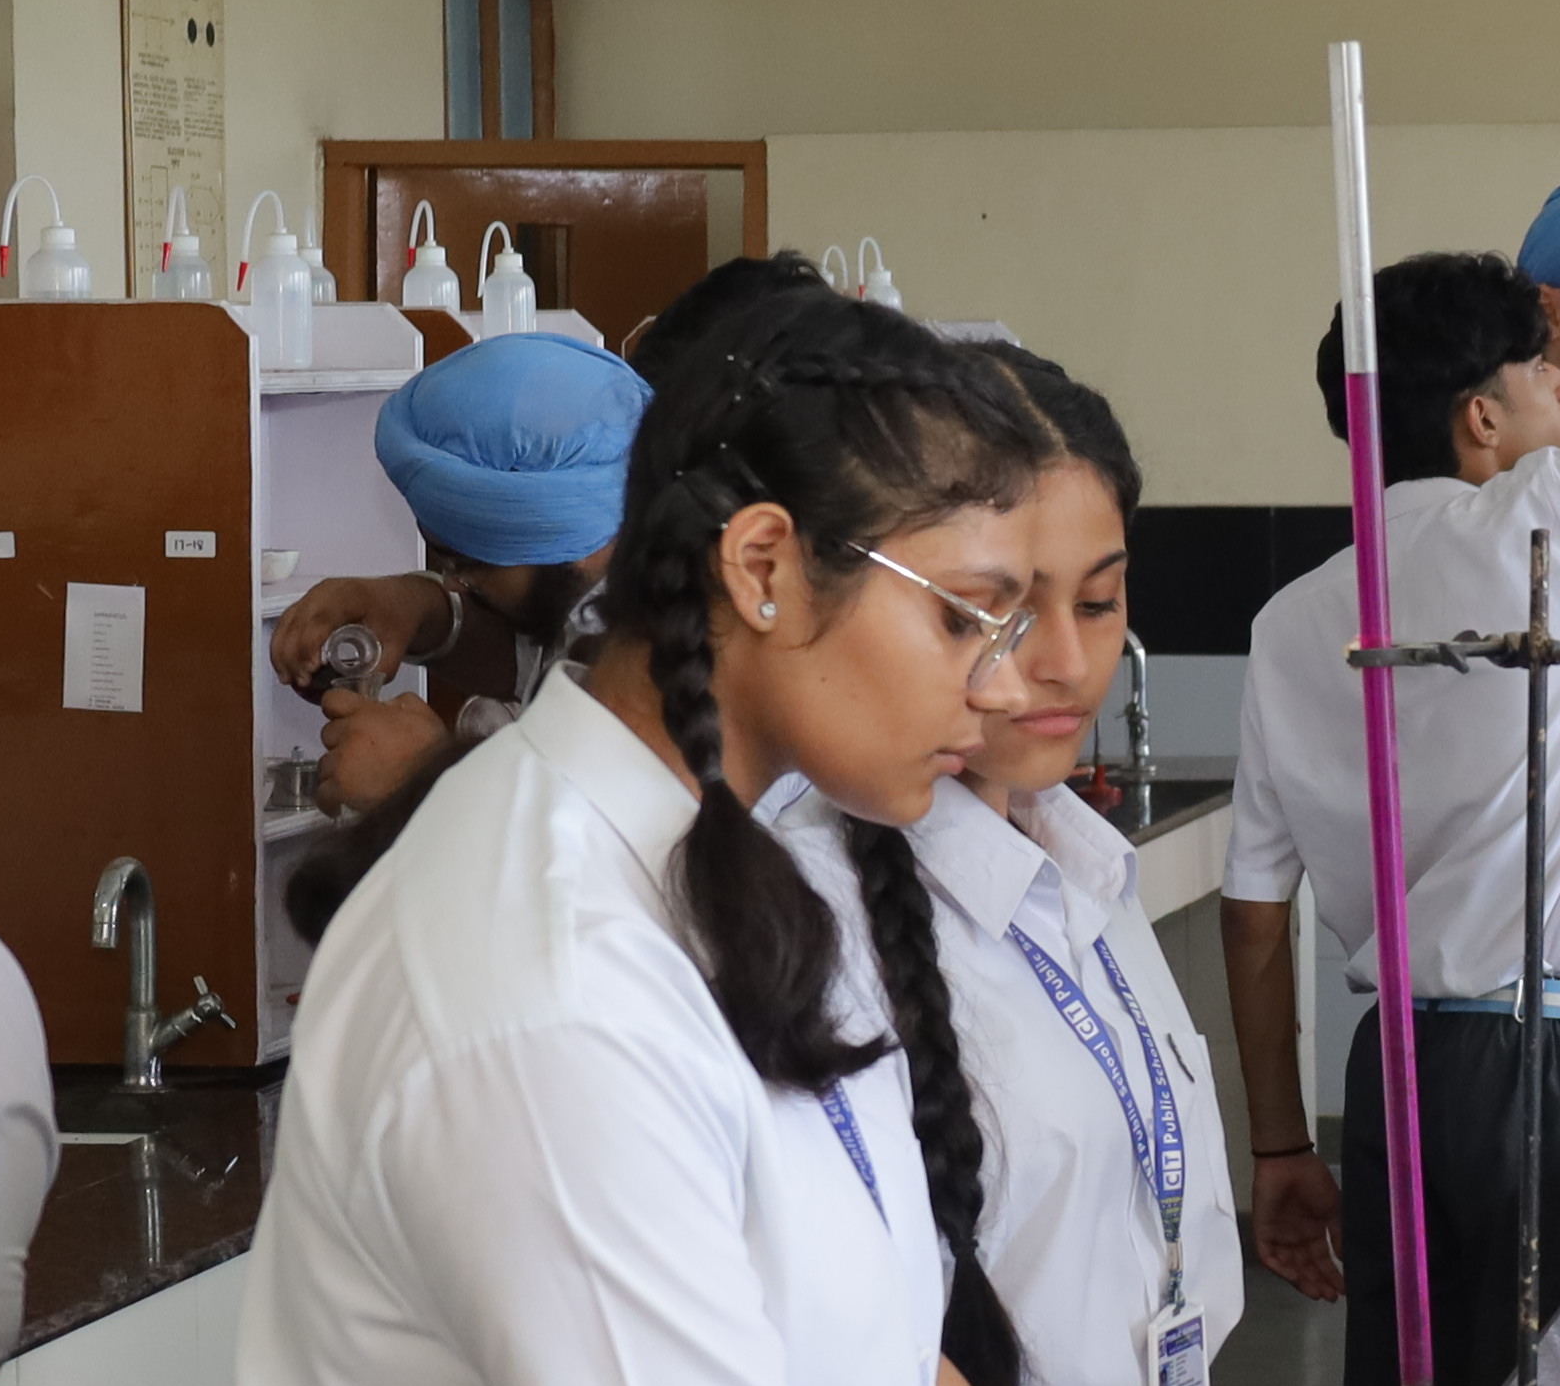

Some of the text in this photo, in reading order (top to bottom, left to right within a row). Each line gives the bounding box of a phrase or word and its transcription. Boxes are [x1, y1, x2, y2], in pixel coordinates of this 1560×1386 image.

[174, 539, 204, 551] 17-18
[1032, 952, 1072, 1003] Public
[1062, 999, 1100, 1042] CT
[1093, 1040, 1128, 1098] School
[1143, 1032, 1167, 1086] School
[1126, 1099, 1145, 1154] Public
[1163, 1091, 1179, 1144] Public
[1162, 1149, 1182, 1191] CT
